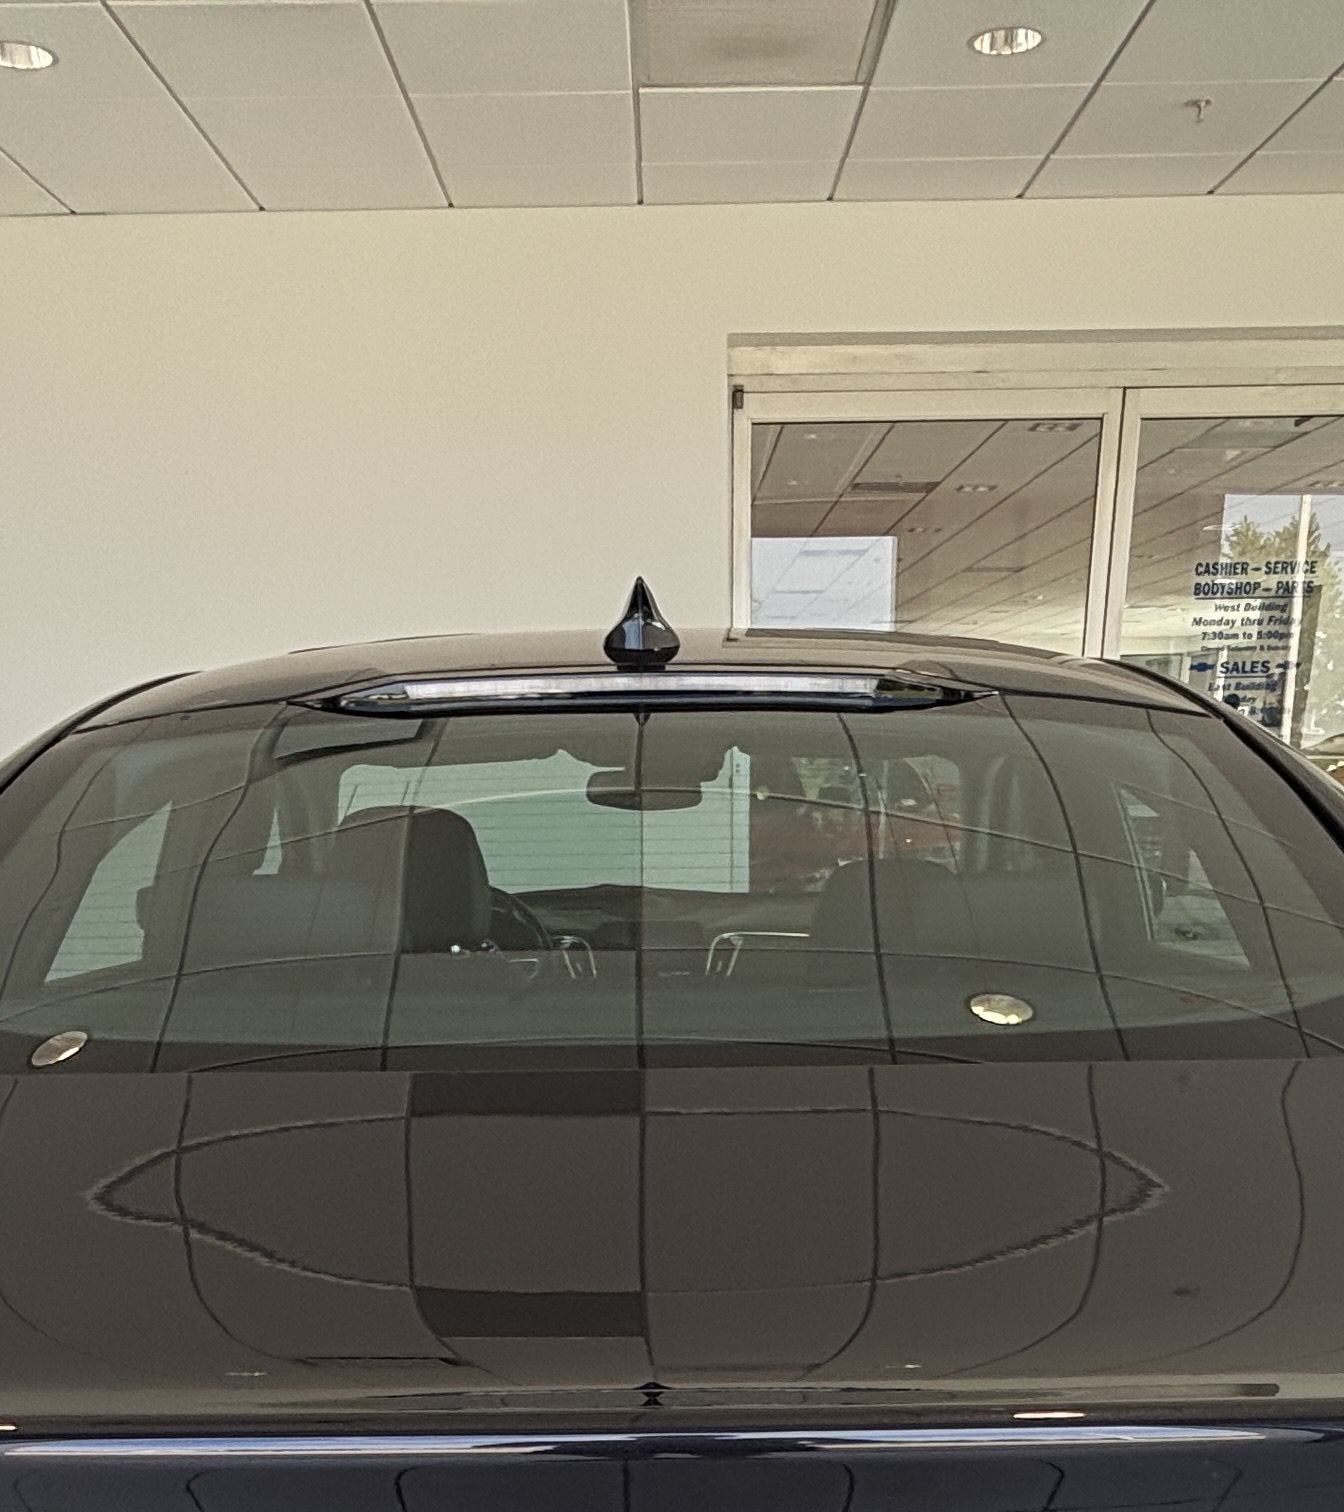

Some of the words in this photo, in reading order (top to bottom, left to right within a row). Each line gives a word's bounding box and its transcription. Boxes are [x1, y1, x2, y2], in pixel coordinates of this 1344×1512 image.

[1194, 561, 1250, 577] CASHIER
[1193, 582, 1262, 597] BODYSHOP
[1275, 580, 1315, 595] PARS
[1214, 603, 1241, 613] West
[1243, 602, 1289, 613] Building
[1191, 616, 1237, 629] Monday
[1240, 616, 1265, 627] thru
[1201, 631, 1239, 641] 7:30am
[1242, 631, 1254, 640] to
[1219, 660, 1272, 675] SALES
